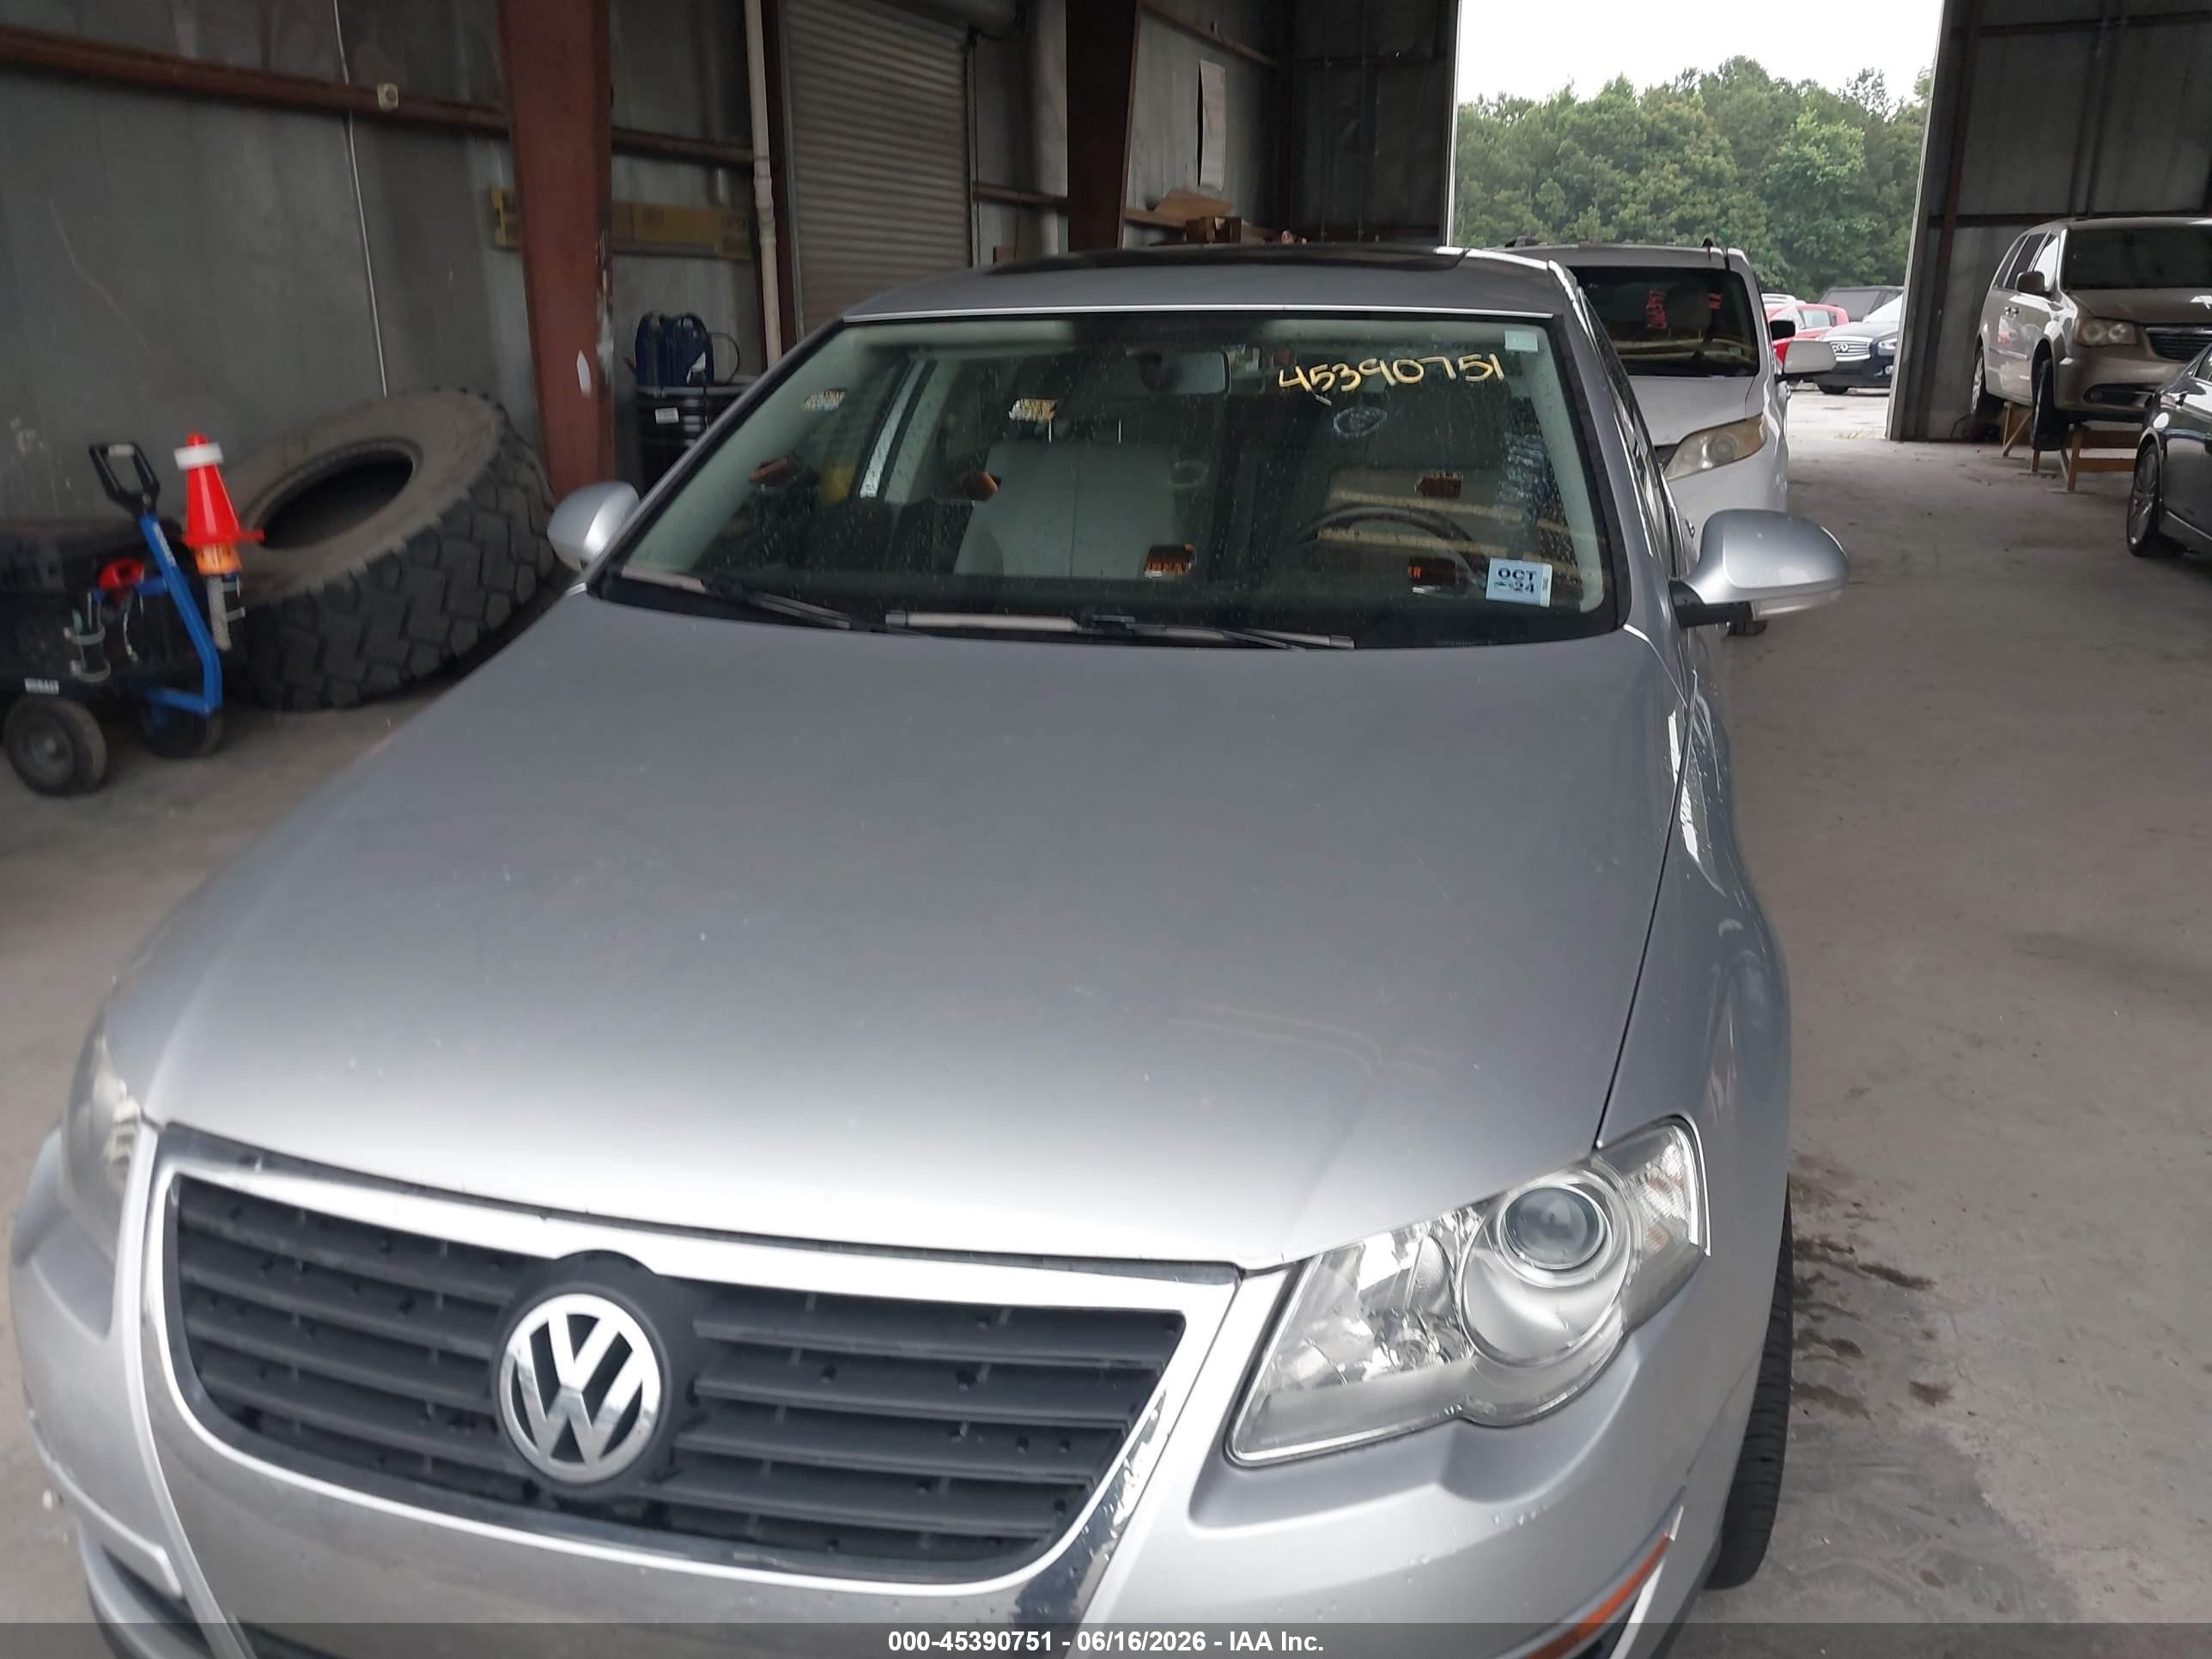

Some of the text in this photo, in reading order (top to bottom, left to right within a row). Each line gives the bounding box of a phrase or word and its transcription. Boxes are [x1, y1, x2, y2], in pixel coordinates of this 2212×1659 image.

[1279, 353, 1504, 392] 45390751
[1498, 568, 1537, 580] OCT
[500, 1294, 661, 1483] VW
